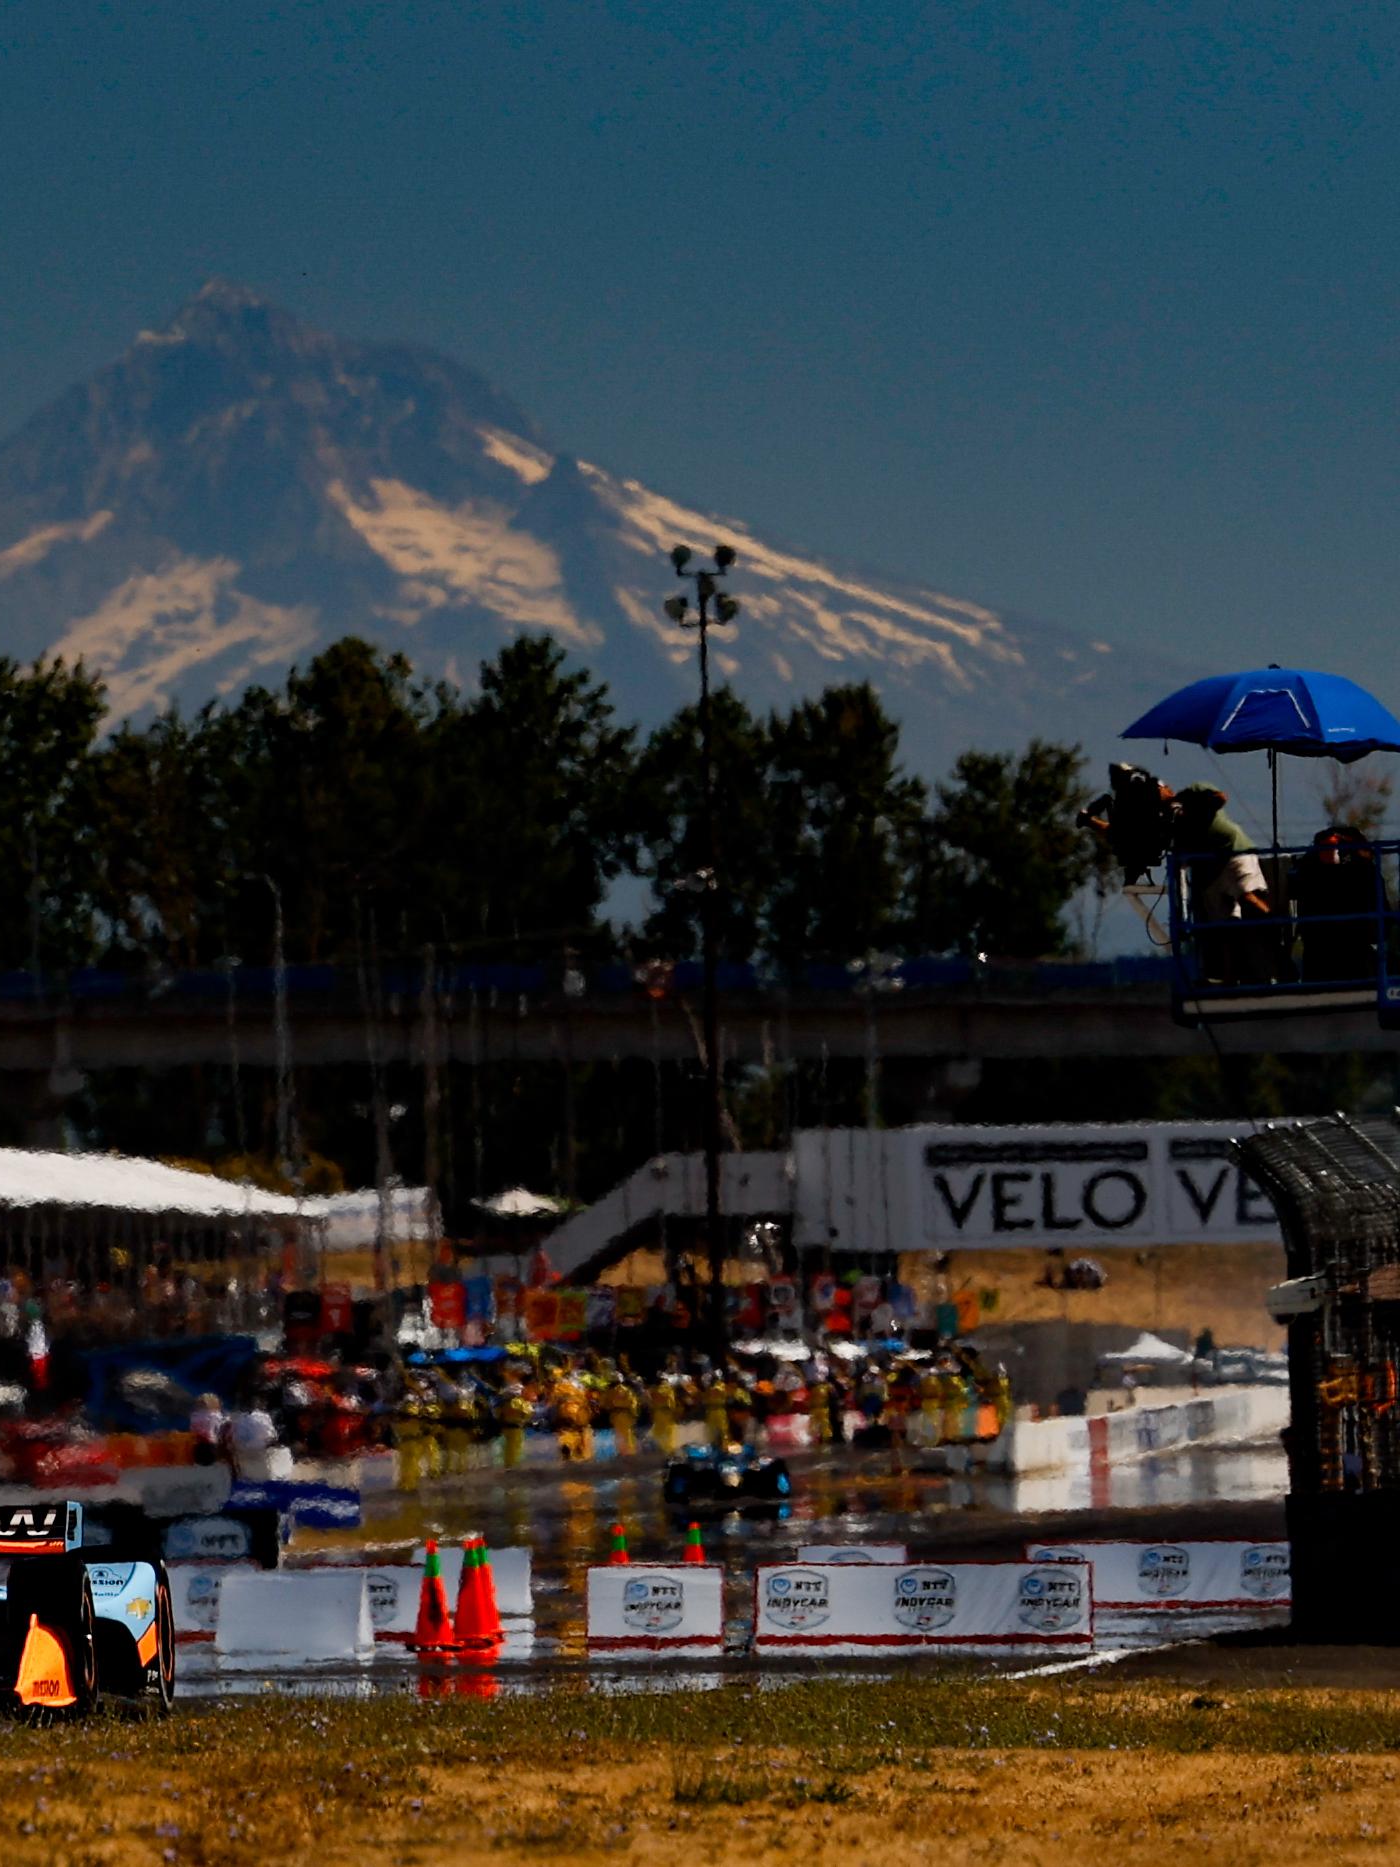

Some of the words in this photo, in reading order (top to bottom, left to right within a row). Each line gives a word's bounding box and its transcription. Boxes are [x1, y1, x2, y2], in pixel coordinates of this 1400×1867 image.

[933, 1170, 1147, 1229] VELO
[795, 1581, 822, 1592] NTT
[922, 1580, 949, 1591] NTT
[652, 1586, 677, 1597] NTT
[766, 1598, 829, 1609] INDYCAR
[896, 1597, 954, 1608] INDYCAR
